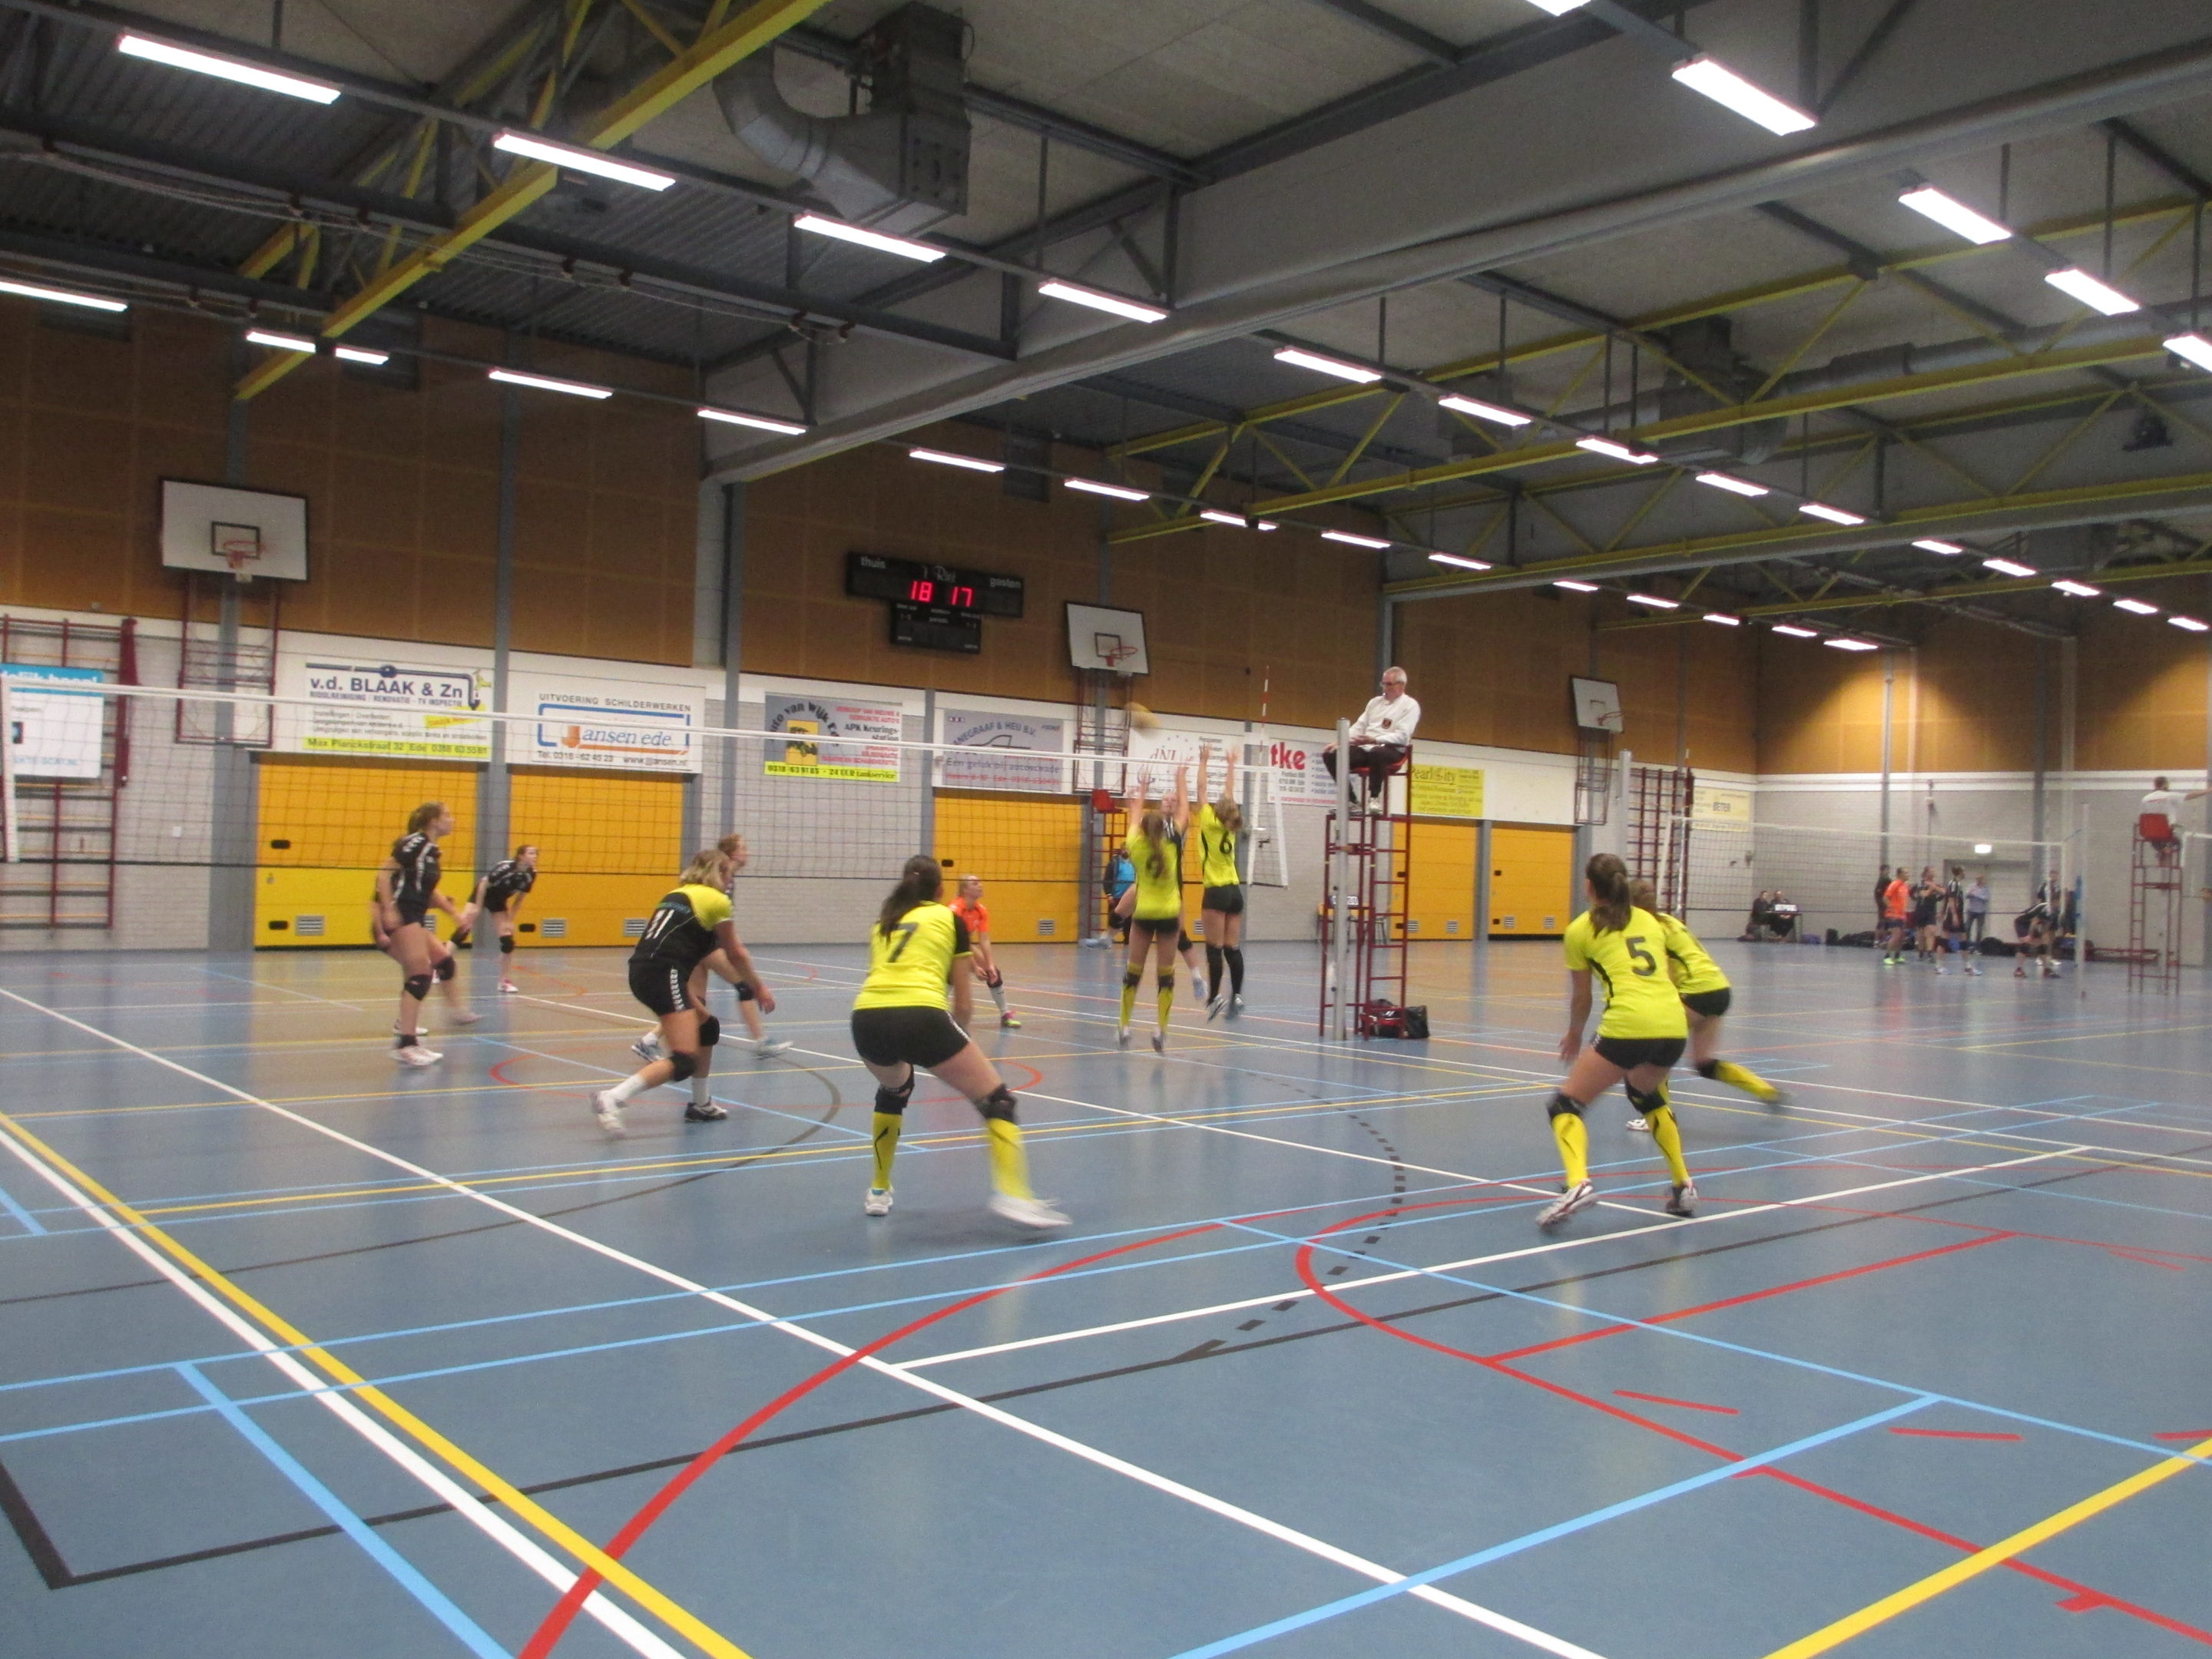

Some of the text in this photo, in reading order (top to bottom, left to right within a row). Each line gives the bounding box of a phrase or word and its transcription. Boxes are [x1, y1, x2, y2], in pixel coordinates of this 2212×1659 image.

[860, 556, 886, 569] thuis
[989, 578, 1022, 589] gasten
[910, 581, 974, 608] 18 17
[310, 677, 462, 698] v.d. BLAAK & Zn
[539, 693, 691, 713] UITVOERING SCHILDERWERKEN
[783, 702, 805, 714] van
[845, 723, 862, 731] APK
[641, 730, 672, 747] ede
[1270, 741, 1306, 770] tke
[1220, 830, 1233, 855] 6
[888, 922, 919, 963] 7
[1625, 936, 1657, 976] 5
